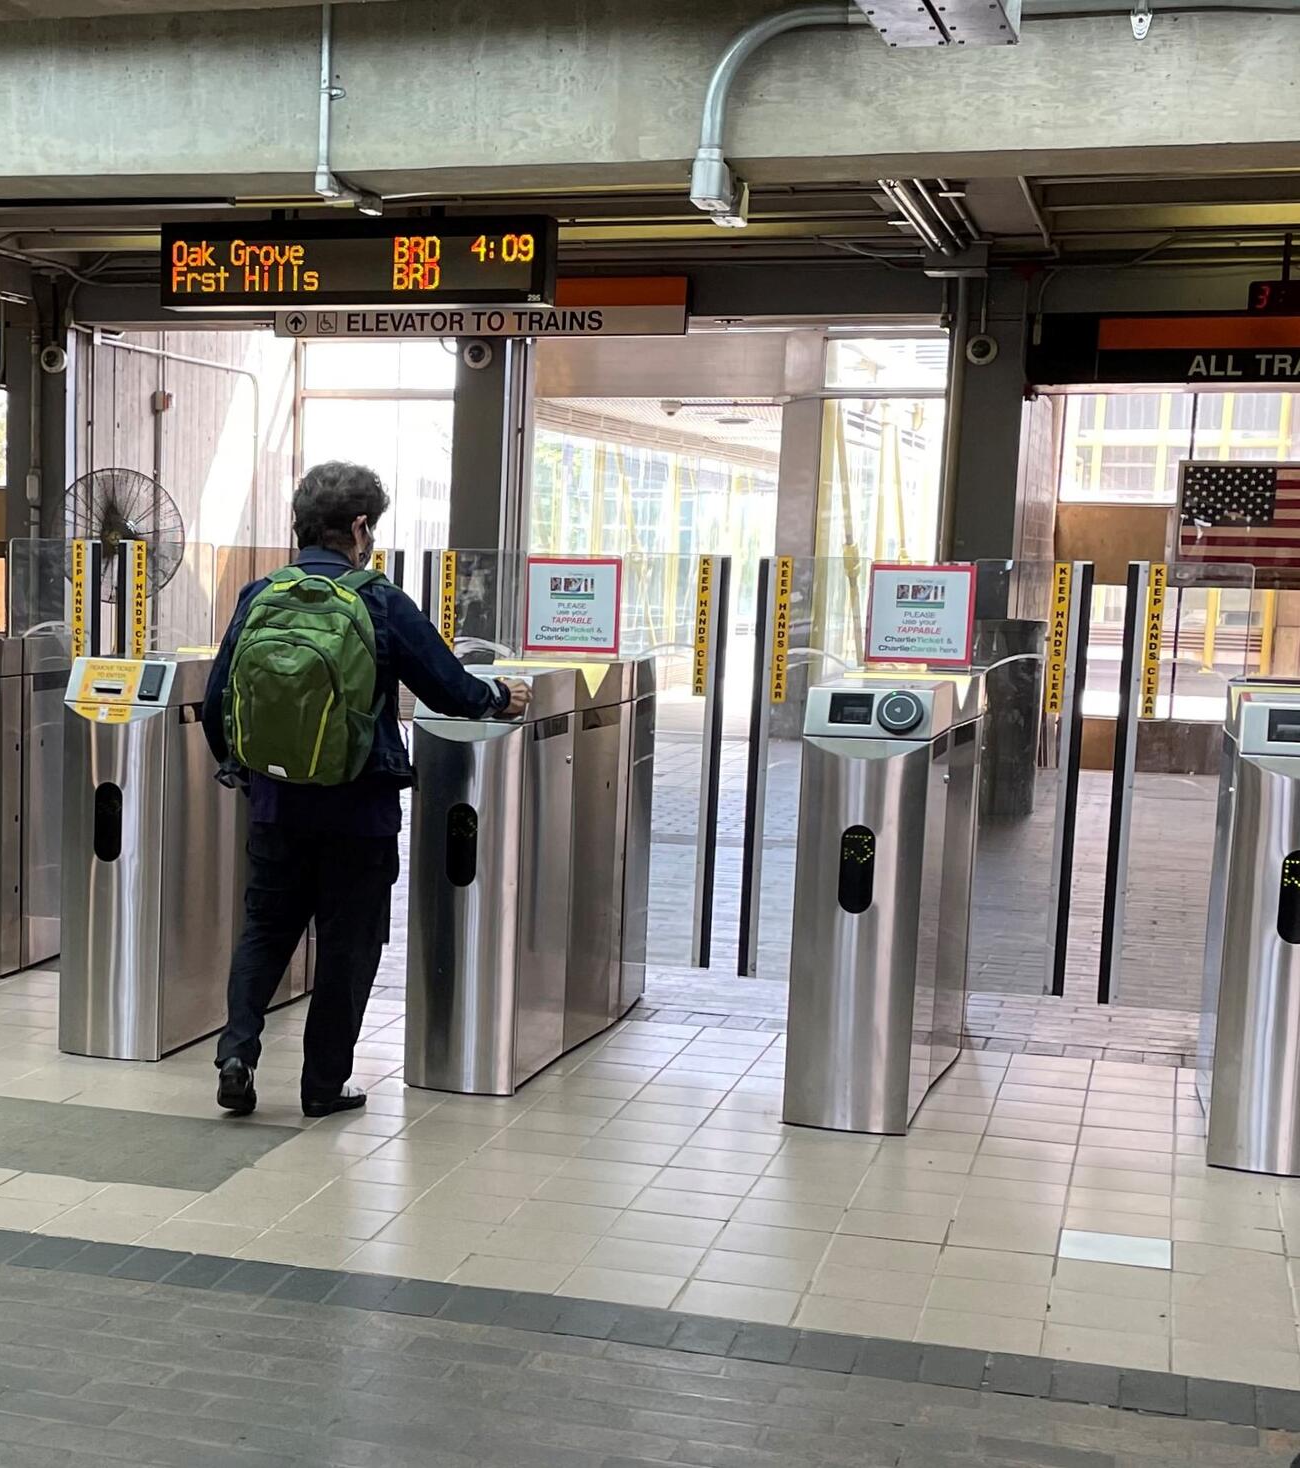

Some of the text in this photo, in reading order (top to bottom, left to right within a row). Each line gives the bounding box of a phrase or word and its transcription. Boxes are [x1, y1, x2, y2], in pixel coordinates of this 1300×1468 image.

[171, 233, 535, 267] Oak Grove BRD 4:09
[171, 262, 441, 293] Frst Hills BRD
[346, 309, 604, 333] ELEVATOR TO TRAINS
[1187, 354, 1243, 377] ALL
[135, 583, 143, 625] HANDS
[443, 554, 453, 638] KEEP HANDS
[540, 625, 594, 633] CharlieTicket
[551, 616, 593, 625] TAPPABLE
[695, 558, 710, 693] KEEP HANDS CLEAR
[774, 560, 790, 699] KEEP HANDS CLEAR
[897, 626, 942, 635] TAPPABLE
[878, 644, 959, 654] CharlieCards here
[884, 635, 944, 645] CharlieTicket
[1049, 567, 1068, 710] KEEP HANDS CLEAR
[1144, 568, 1164, 714] KEEP HANDS CLEAR
